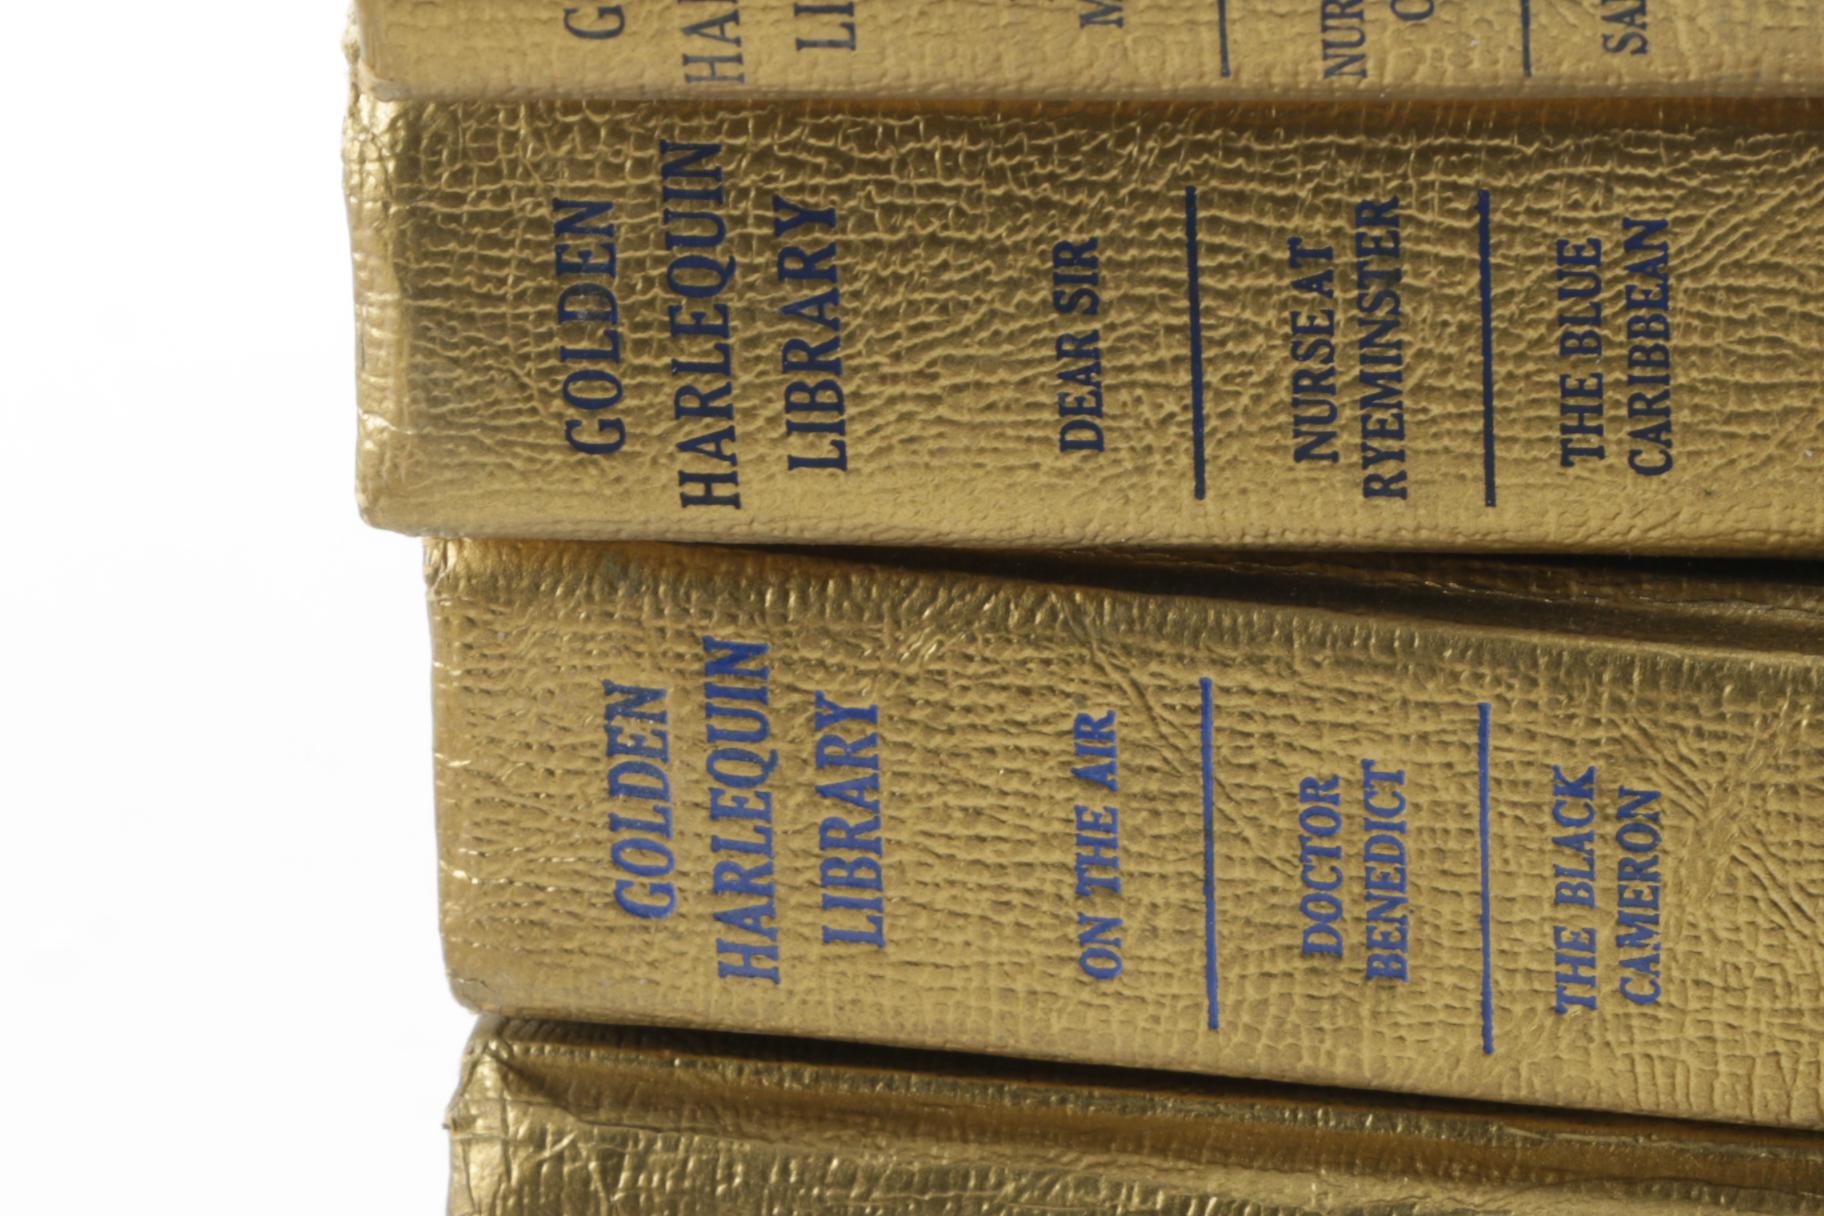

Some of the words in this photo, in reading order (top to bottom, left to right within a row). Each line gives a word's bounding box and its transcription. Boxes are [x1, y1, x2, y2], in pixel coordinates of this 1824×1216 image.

[552, 198, 626, 454] GOLDEN
[659, 139, 741, 507] HARLEQUIN
[772, 195, 847, 469] LIBRARY
[1052, 238, 1101, 316] SIR
[1288, 236, 1334, 298] AT
[1353, 196, 1408, 498] RYEMINSTER
[1555, 238, 1605, 357] BLUE
[1622, 217, 1673, 476] CARIBBEAN
[1056, 330, 1105, 452] DEAR
[1290, 309, 1340, 462] NURSE
[1558, 372, 1606, 467] THE
[604, 681, 677, 919] GOLDEN
[702, 636, 780, 983] HARLEQUIN
[815, 691, 885, 948] LIBRARY
[1072, 711, 1119, 792] AIR
[1075, 806, 1121, 897] THE
[1299, 775, 1344, 957] DOCTOR
[1362, 759, 1409, 982] BENEDICT
[1552, 765, 1597, 908] BLACK
[1616, 786, 1662, 1005] CAMERON
[1078, 913, 1124, 980] ON
[1554, 926, 1598, 1015] THE
